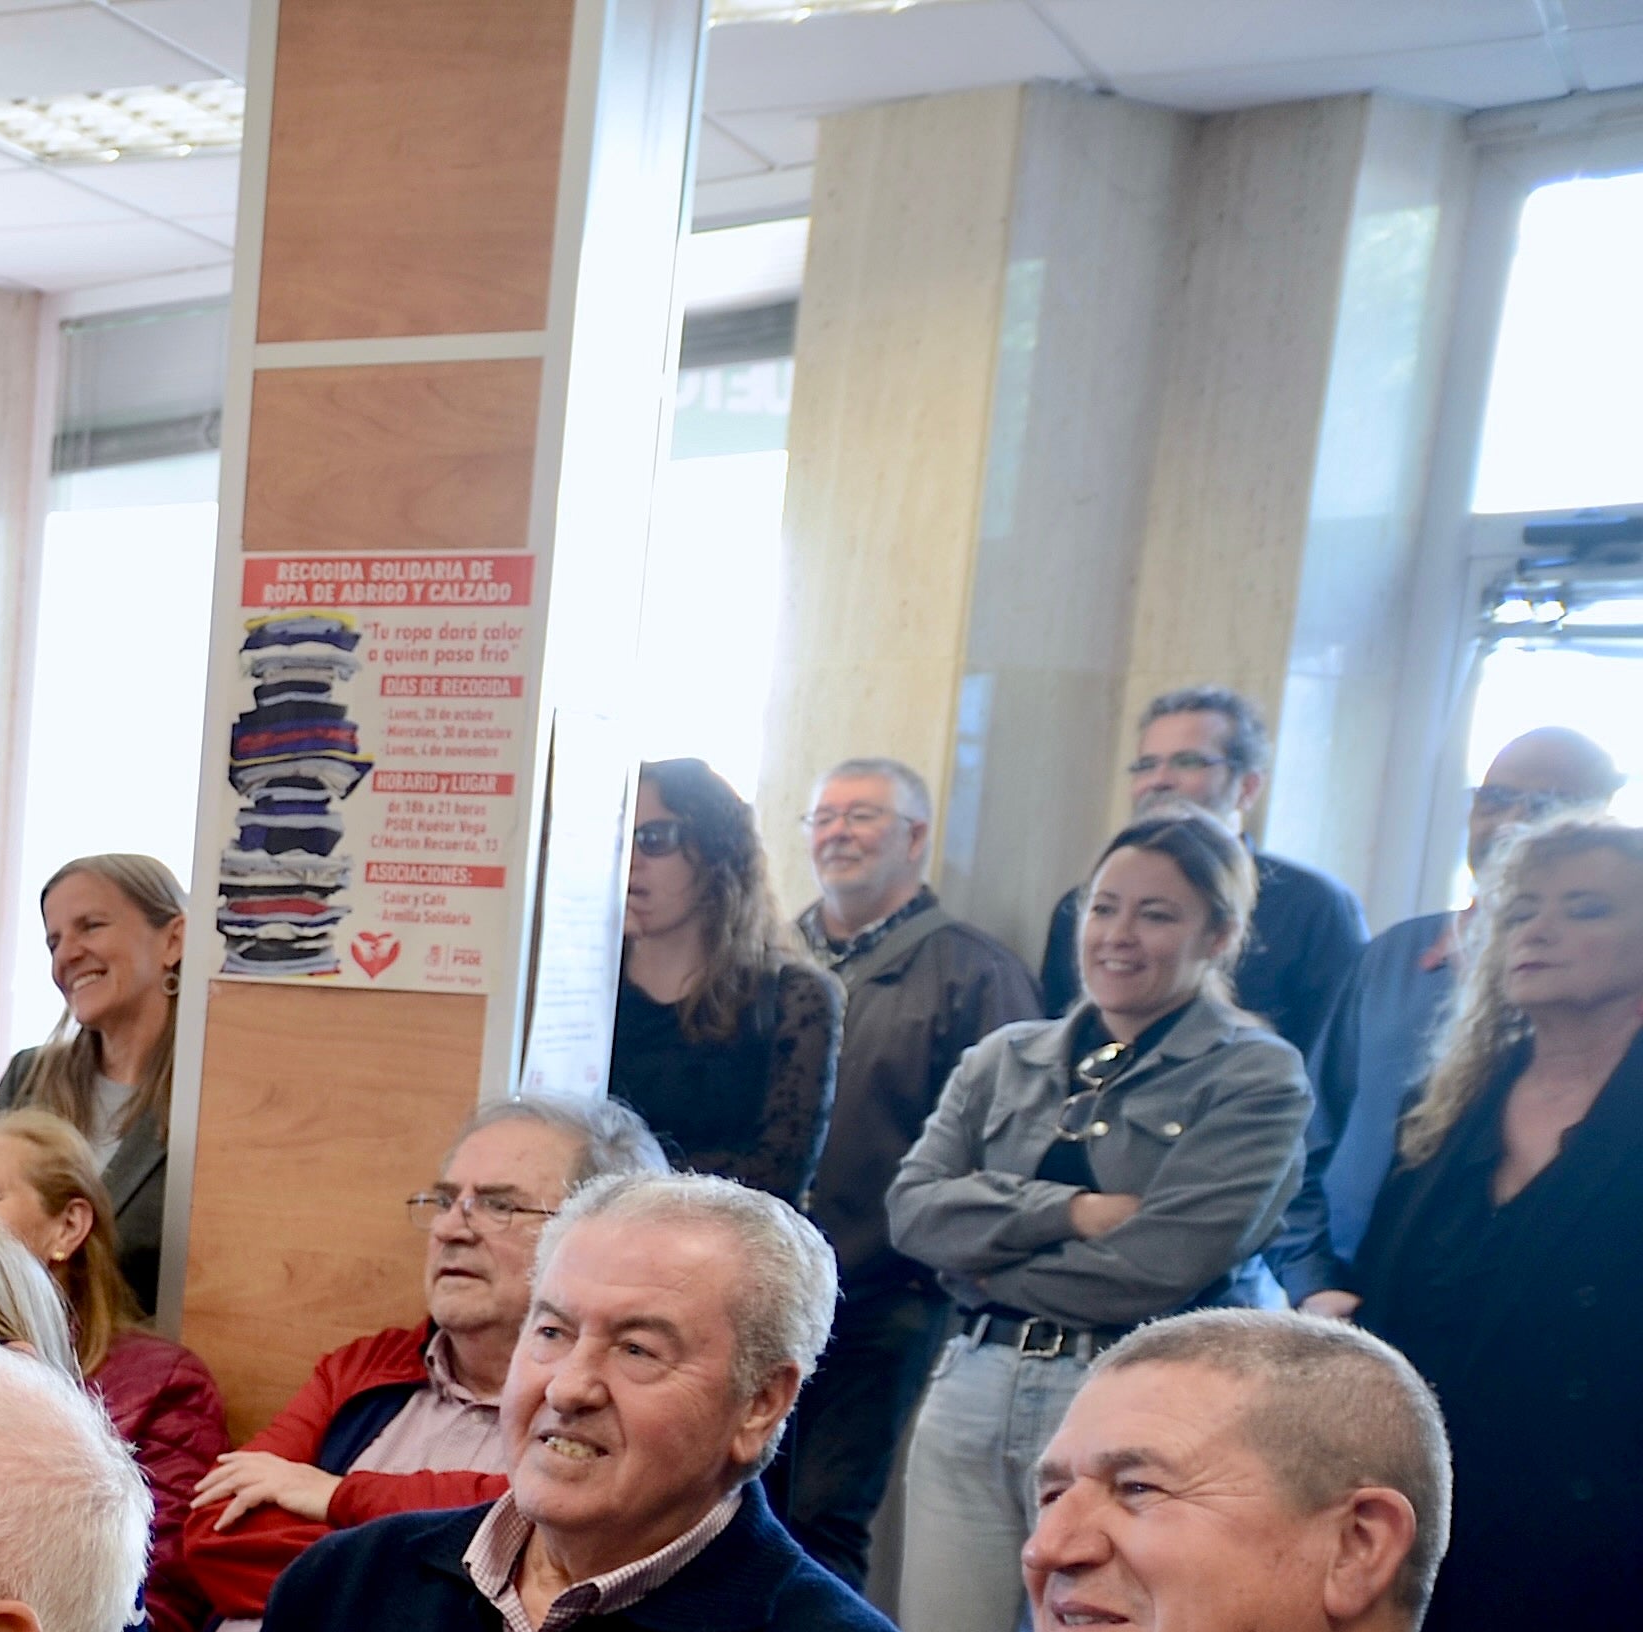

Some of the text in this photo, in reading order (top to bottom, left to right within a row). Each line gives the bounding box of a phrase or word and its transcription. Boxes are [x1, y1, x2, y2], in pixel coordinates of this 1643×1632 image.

[277, 560, 495, 582] RECOGIDA SOLIDARIA DE
[263, 584, 309, 603] ROPA
[314, 584, 337, 602] DE
[340, 583, 407, 602] ABRIGO
[428, 582, 512, 603] CALZADO
[396, 626, 433, 644] ropa
[483, 621, 524, 640] calor
[434, 648, 475, 666] pasa
[421, 677, 440, 695] DE
[442, 678, 511, 696] RECOGIDA
[439, 707, 451, 720] de
[375, 773, 438, 791] HORARIO
[451, 774, 498, 792] LUGAR
[368, 863, 473, 884] ASOCIACIONES:
